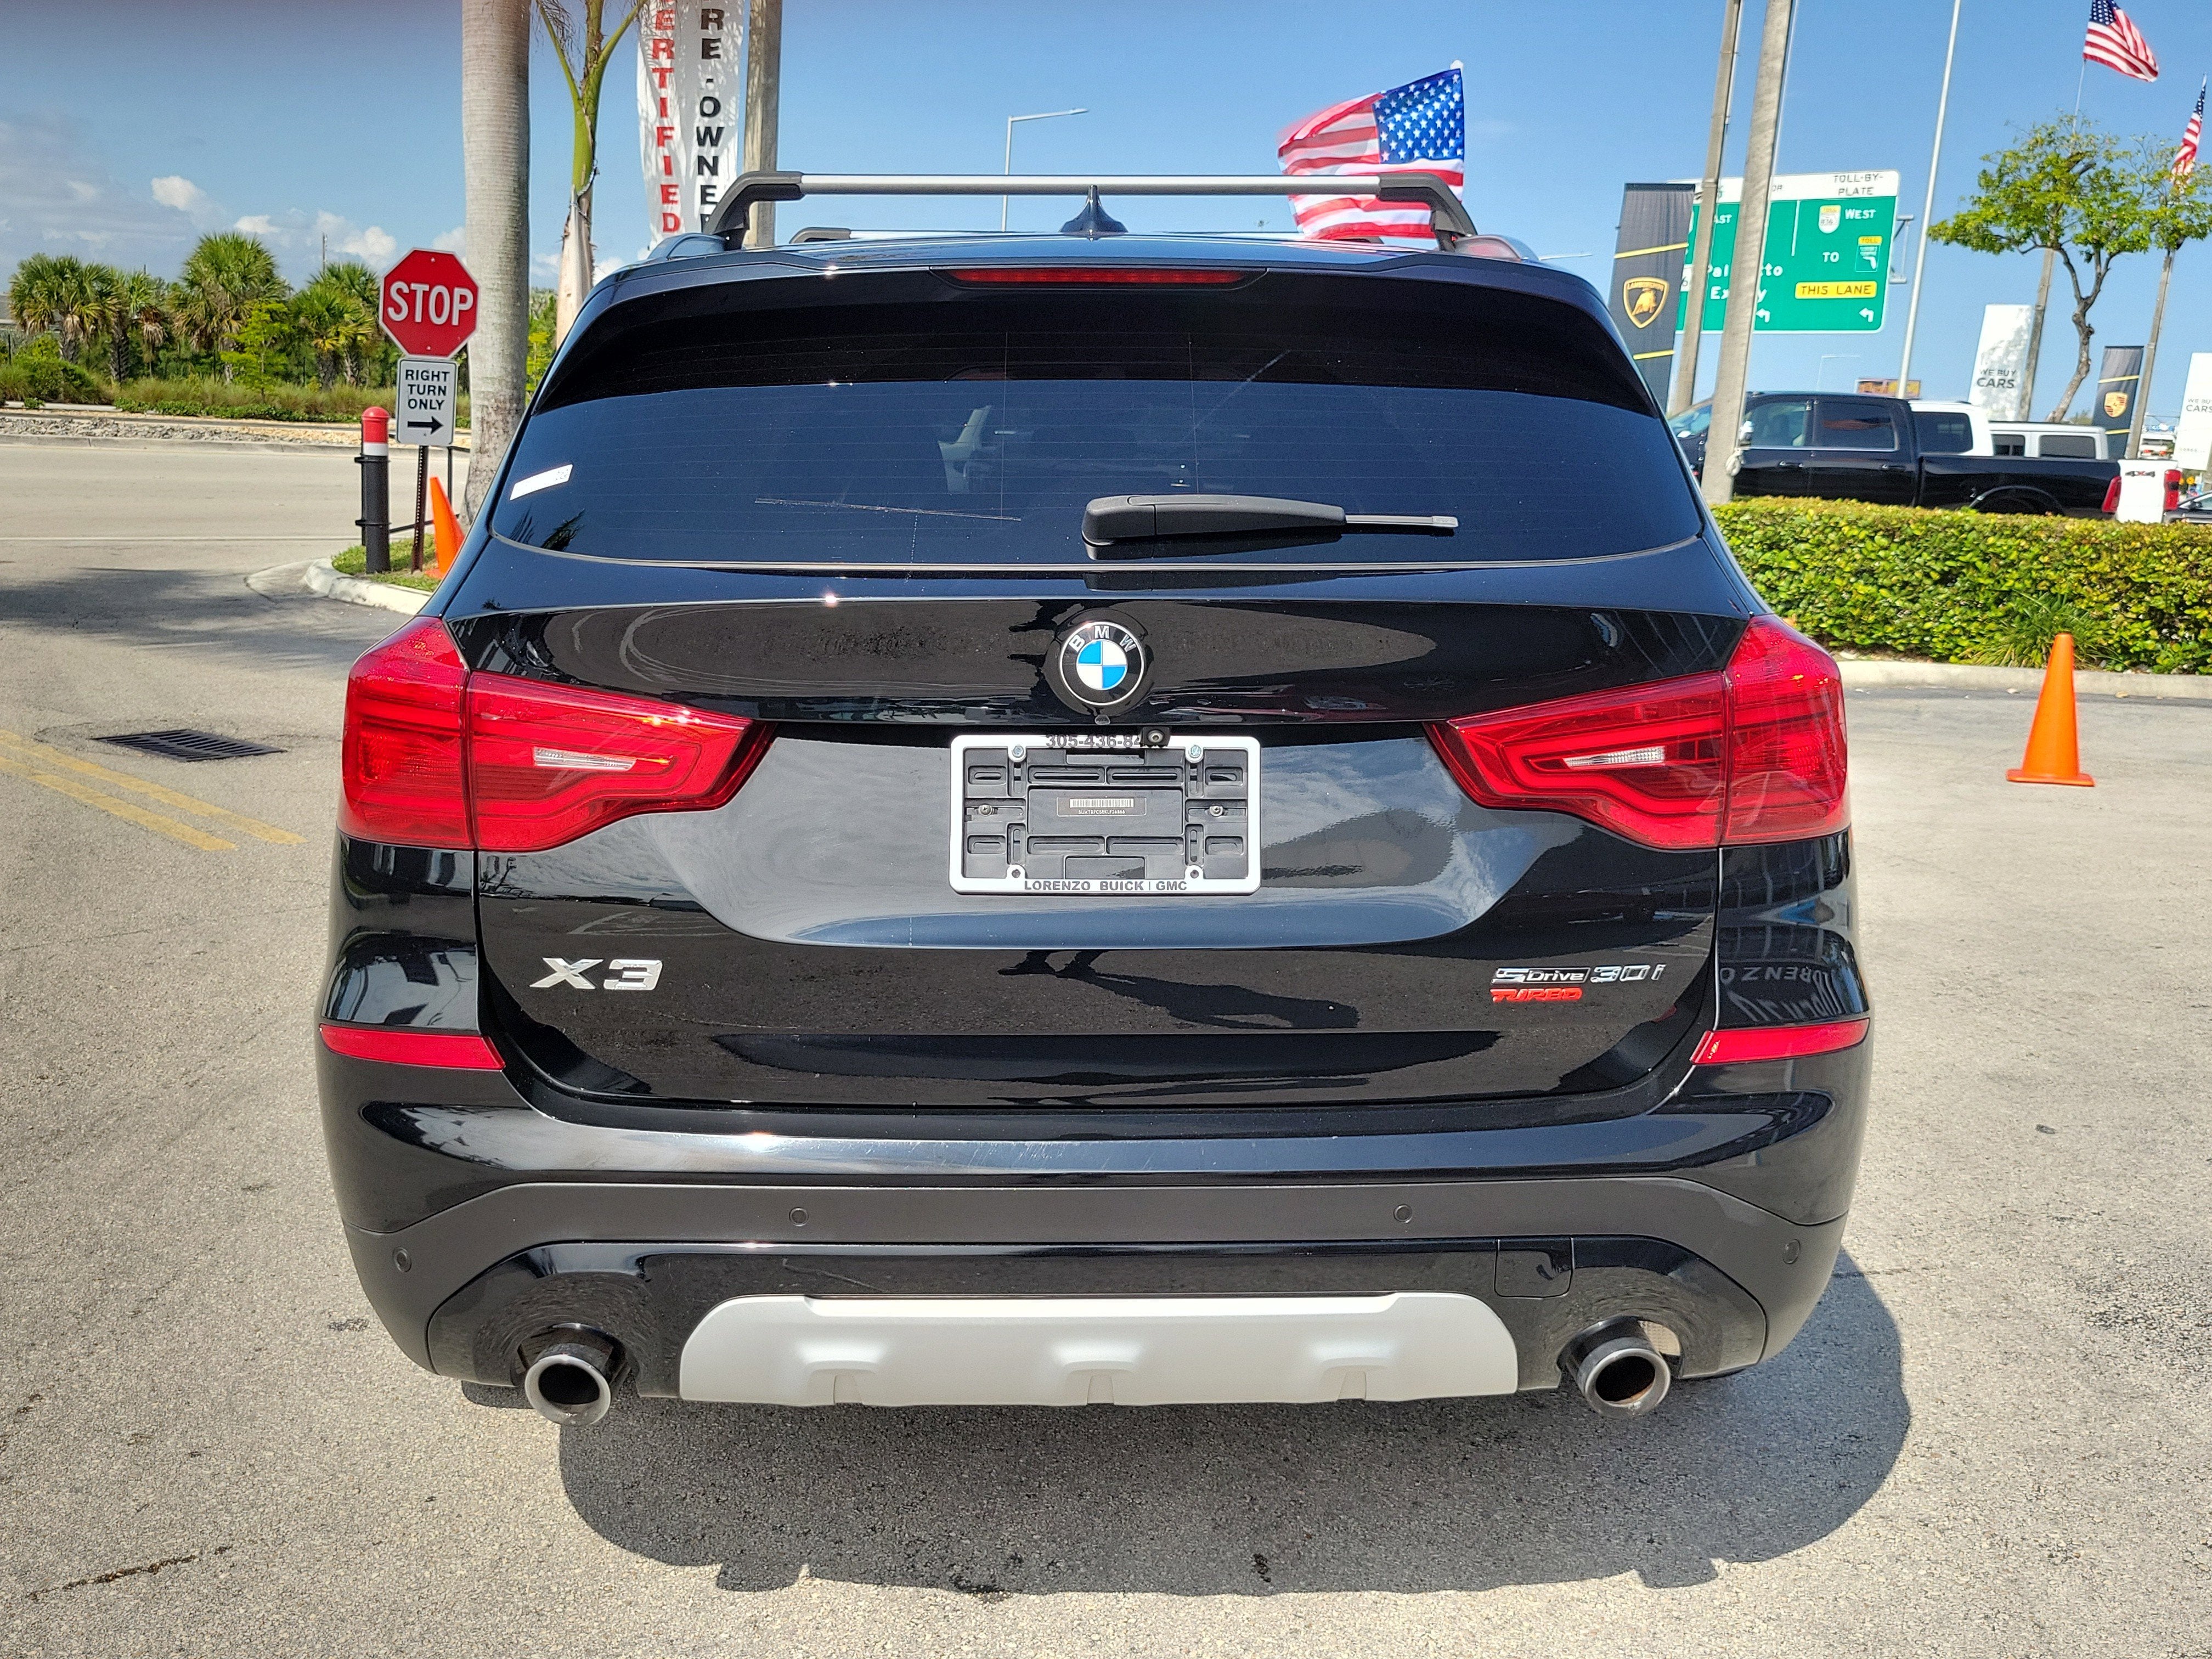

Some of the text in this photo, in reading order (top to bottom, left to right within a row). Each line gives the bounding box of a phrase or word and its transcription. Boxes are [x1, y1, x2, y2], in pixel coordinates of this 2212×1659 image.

[651, 0, 681, 233] ERTIFIED
[696, 0, 725, 232] RE-OWNE
[1833, 173, 1883, 183] TOLL-BY-
[1838, 187, 1874, 196] PLATE
[1713, 214, 1733, 224] AST
[1844, 208, 1877, 219] WEST
[1822, 251, 1840, 263] TO
[1801, 285, 1872, 295] THIS LANE
[387, 280, 474, 326] STOP
[405, 369, 450, 382] RIGHT
[1977, 377, 2015, 389] CARS
[408, 384, 447, 397] TURN
[408, 398, 445, 410] ONLY
[1069, 625, 1137, 652] BMW
[1046, 733, 1141, 748] 305-436-84
[1024, 880, 1188, 891] LORENZO BUICK GMC
[528, 957, 663, 991] X3
[1489, 986, 1583, 1003] TURBO
